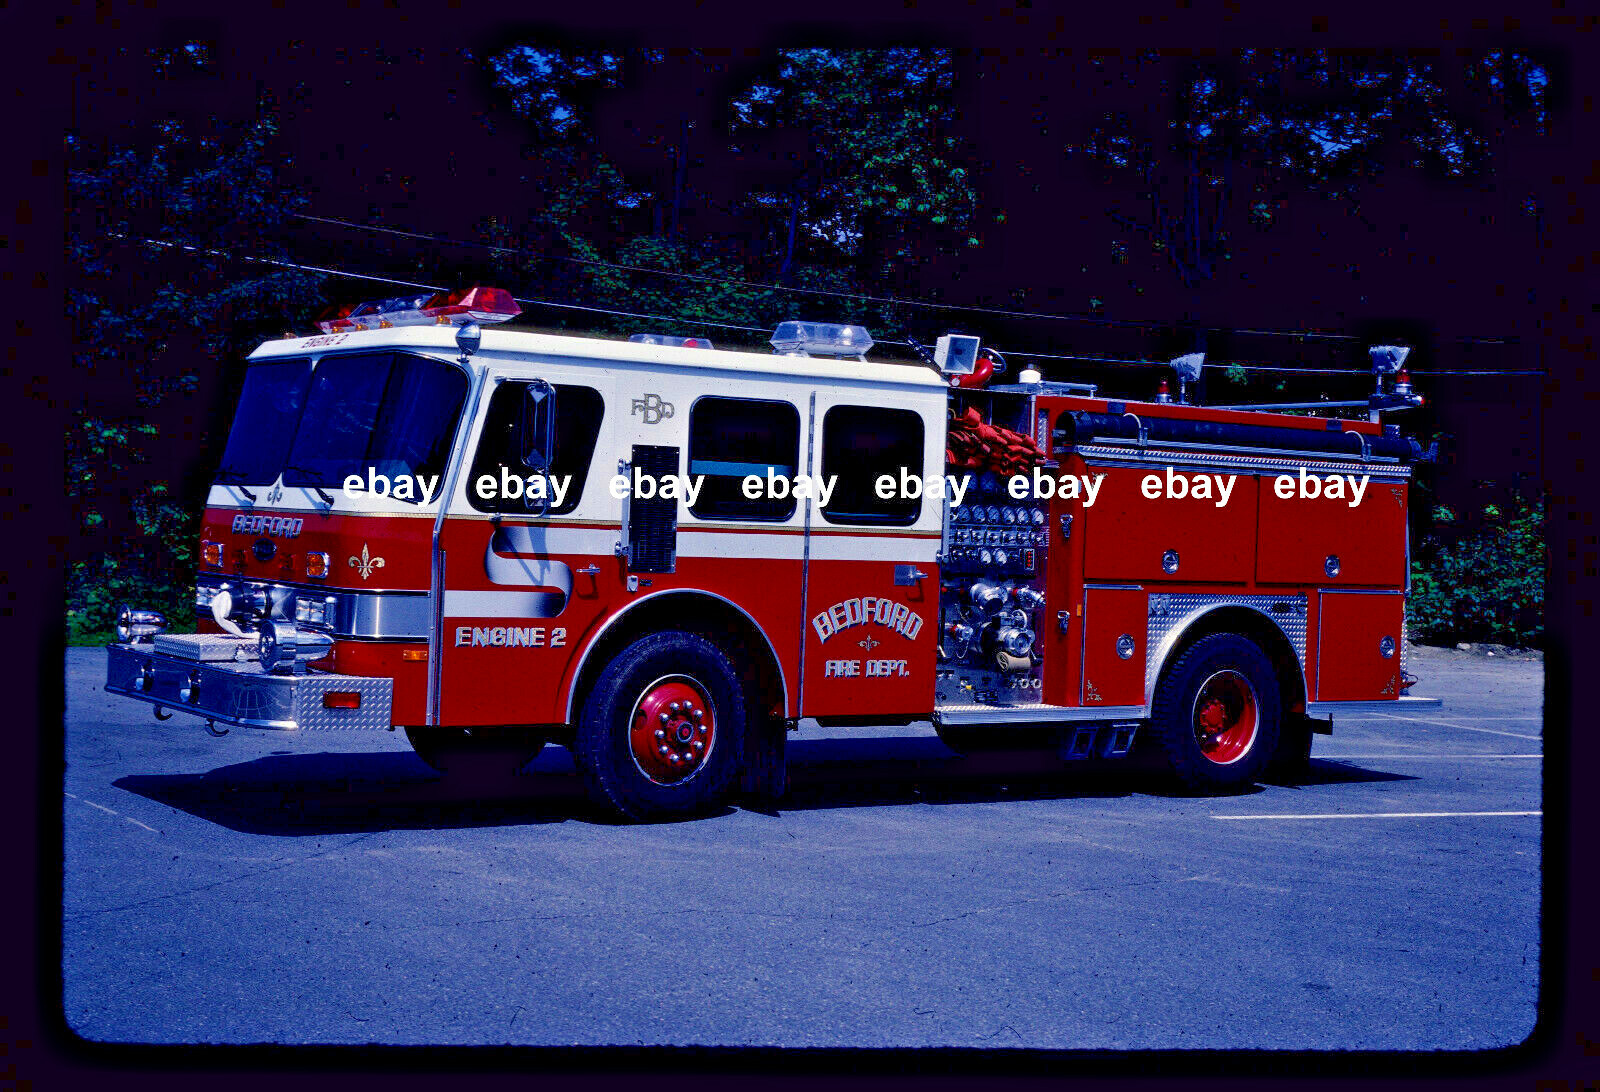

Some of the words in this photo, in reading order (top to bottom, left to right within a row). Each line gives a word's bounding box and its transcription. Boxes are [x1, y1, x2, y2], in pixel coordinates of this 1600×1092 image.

[301, 334, 338, 348] ENGINE
[336, 333, 350, 344] 2
[232, 514, 304, 538] BEDFORD
[812, 596, 924, 645] BEDFORD
[455, 626, 545, 648] ENGINE
[550, 627, 567, 648] 2
[825, 660, 861, 677] FIRE
[866, 660, 910, 677] DEPT.
